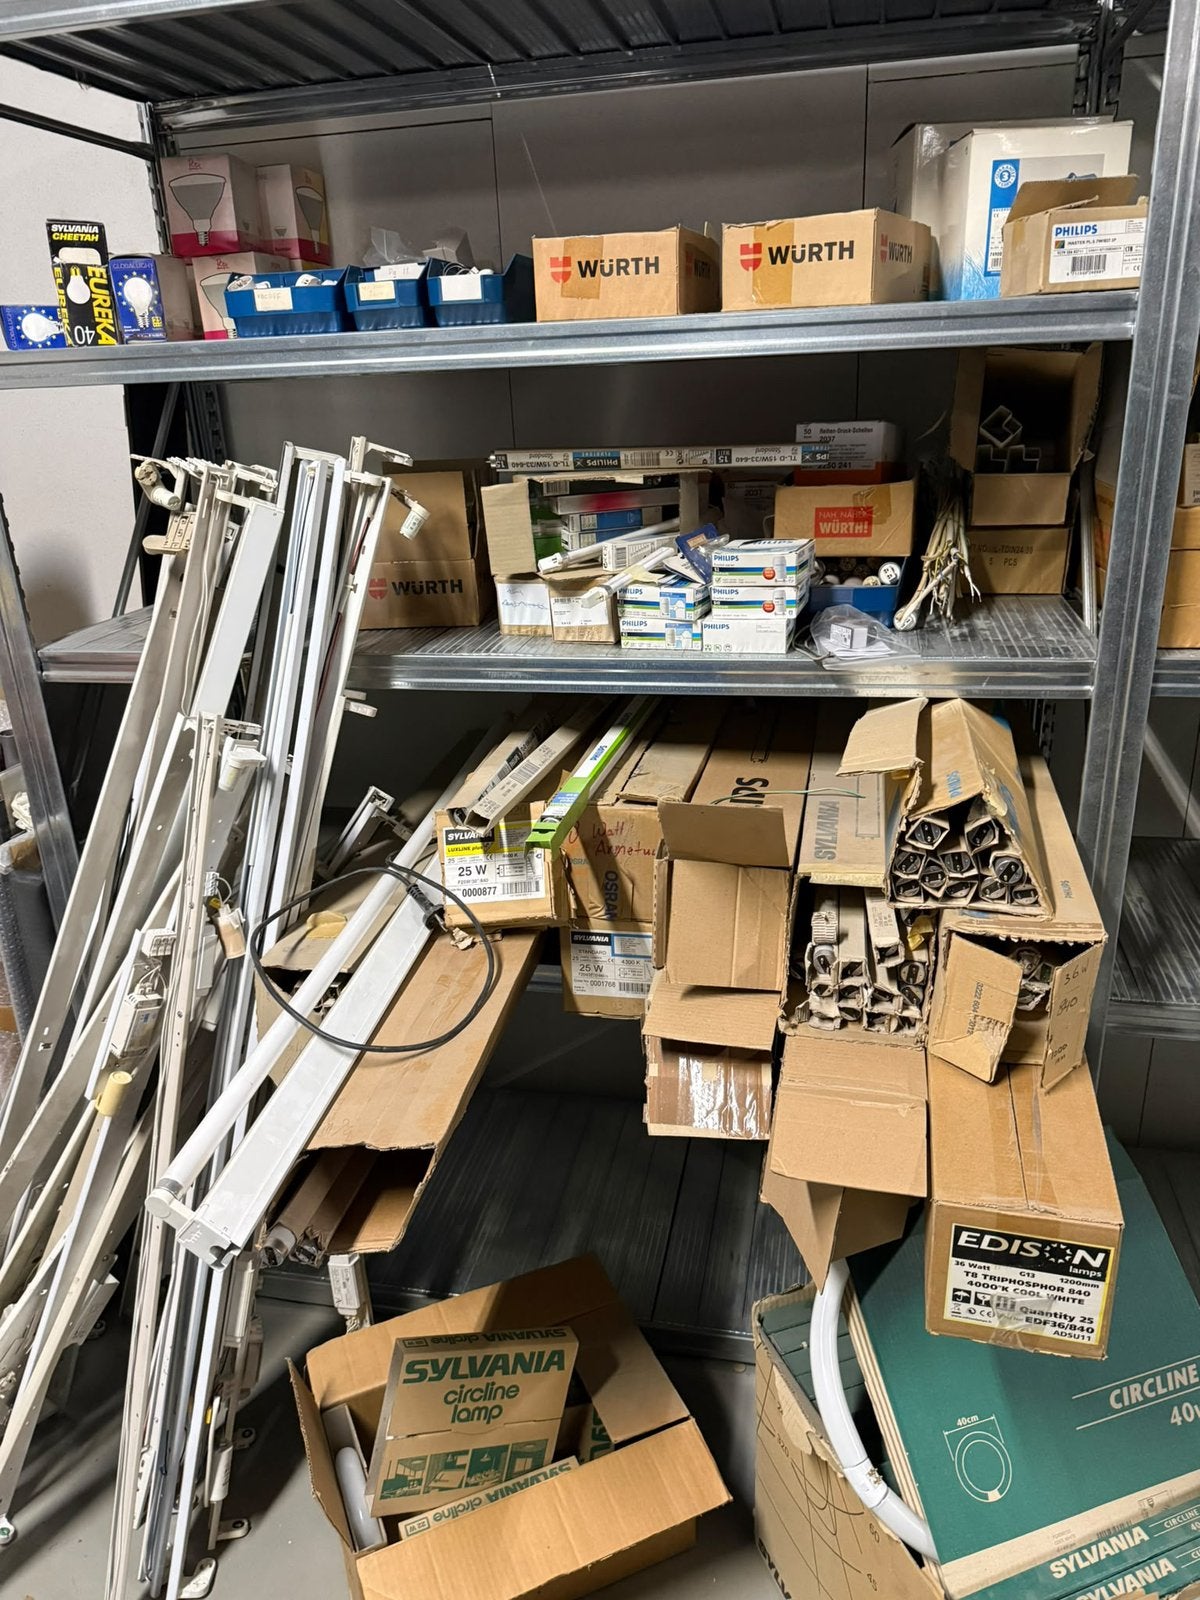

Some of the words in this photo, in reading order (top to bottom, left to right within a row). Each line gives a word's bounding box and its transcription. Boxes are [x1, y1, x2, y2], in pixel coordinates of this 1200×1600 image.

[51, 224, 99, 233] SYLVANIA
[52, 233, 99, 242] CHEETAH
[1055, 224, 1098, 237] PHILIPS
[767, 240, 855, 266] WÜRTH
[577, 256, 660, 278] WÜRTH
[87, 266, 117, 345] EUREKA
[74, 325, 95, 345] 40
[754, 446, 784, 454] Standard
[586, 458, 618, 466] PHILIPS
[718, 455, 730, 464] 15
[819, 520, 869, 535] WÜRTH!
[391, 579, 464, 596] WÜRTH
[814, 800, 840, 860] SYLVANIA
[458, 866, 472, 877] 25
[475, 864, 487, 876] W
[462, 886, 497, 898] 0000877
[573, 934, 609, 942] SYLVANIA
[579, 963, 592, 972] 25
[593, 965, 604, 973] W
[1063, 967, 1080, 986] 36
[957, 1230, 1105, 1268] EDISON
[968, 1261, 991, 1271] Watt
[1019, 1271, 1036, 1279] G13
[1069, 1265, 1102, 1278] lamps
[964, 1270, 978, 1279] T8
[982, 1273, 1065, 1293] TRIPHOSPHOR
[1068, 1288, 1091, 1297] 840
[1059, 1277, 1100, 1289] 1200mm
[1012, 1288, 1042, 1299] COOL
[1046, 1293, 1085, 1306] WHITE
[1019, 1306, 1076, 1322] Quantity
[1079, 1316, 1094, 1325] 25
[1025, 1316, 1095, 1335] EDF36/840
[430, 1334, 480, 1345] circline
[482, 1329, 567, 1343] SYLVANIA
[402, 1349, 565, 1384] SYLVANIA
[443, 1382, 520, 1406] circline
[1109, 1363, 1200, 1409] CIRCLINE
[451, 1404, 504, 1425] lamp
[957, 1415, 979, 1428] 40cm
[484, 1461, 572, 1502] SYLVANIA
[432, 1497, 483, 1522] circline
[1163, 1508, 1200, 1529] CIRCLINE
[1050, 1525, 1150, 1579] SYLVANIA
[1075, 1557, 1177, 1600] SYLVANIA
